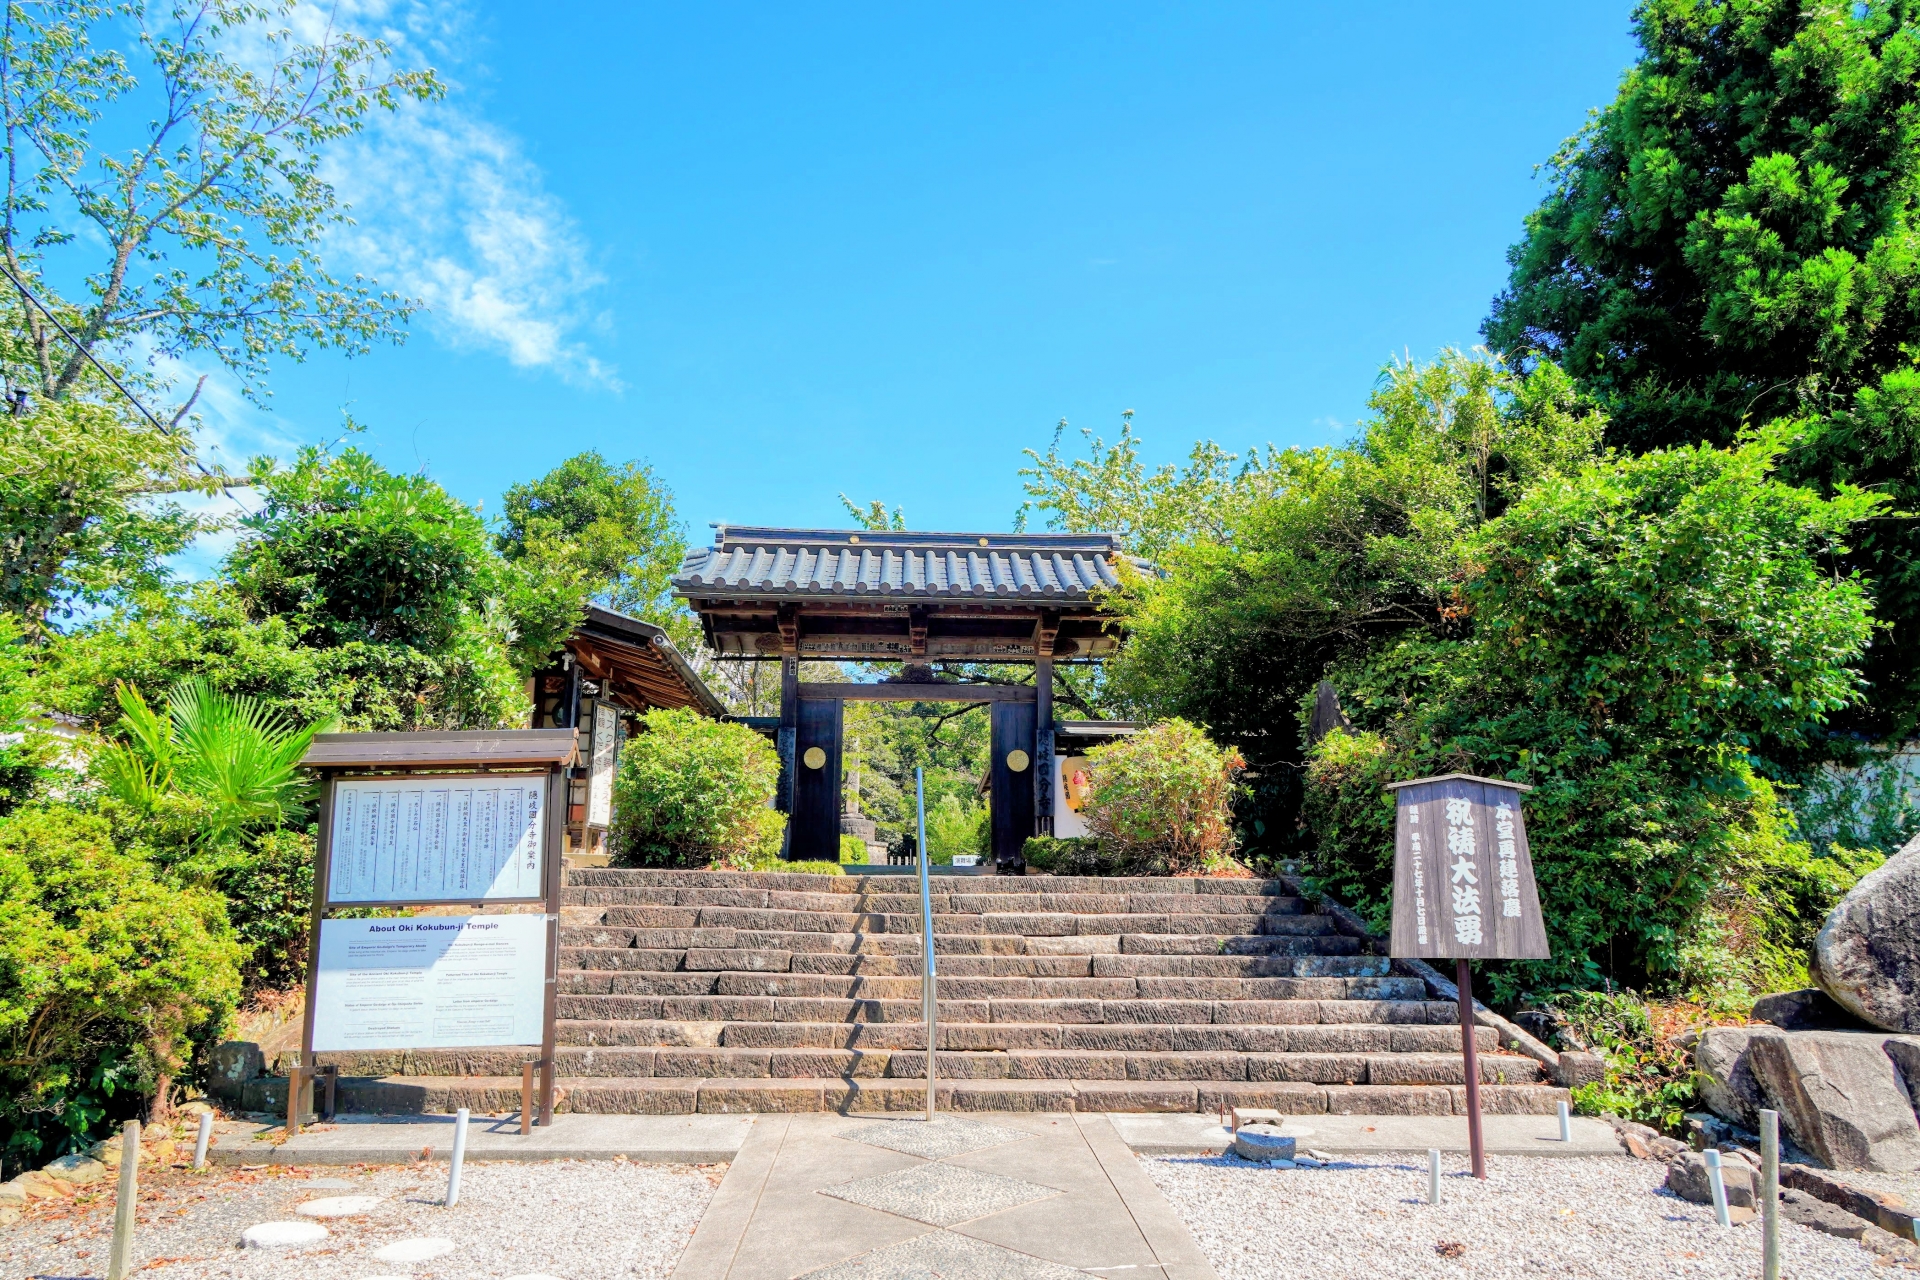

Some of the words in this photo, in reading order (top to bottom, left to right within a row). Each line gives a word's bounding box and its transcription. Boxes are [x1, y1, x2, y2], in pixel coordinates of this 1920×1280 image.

[368, 925, 396, 933] About
[398, 924, 414, 932] Oki
[416, 923, 464, 931] Kokubun-ji
[466, 922, 499, 931] Temple
